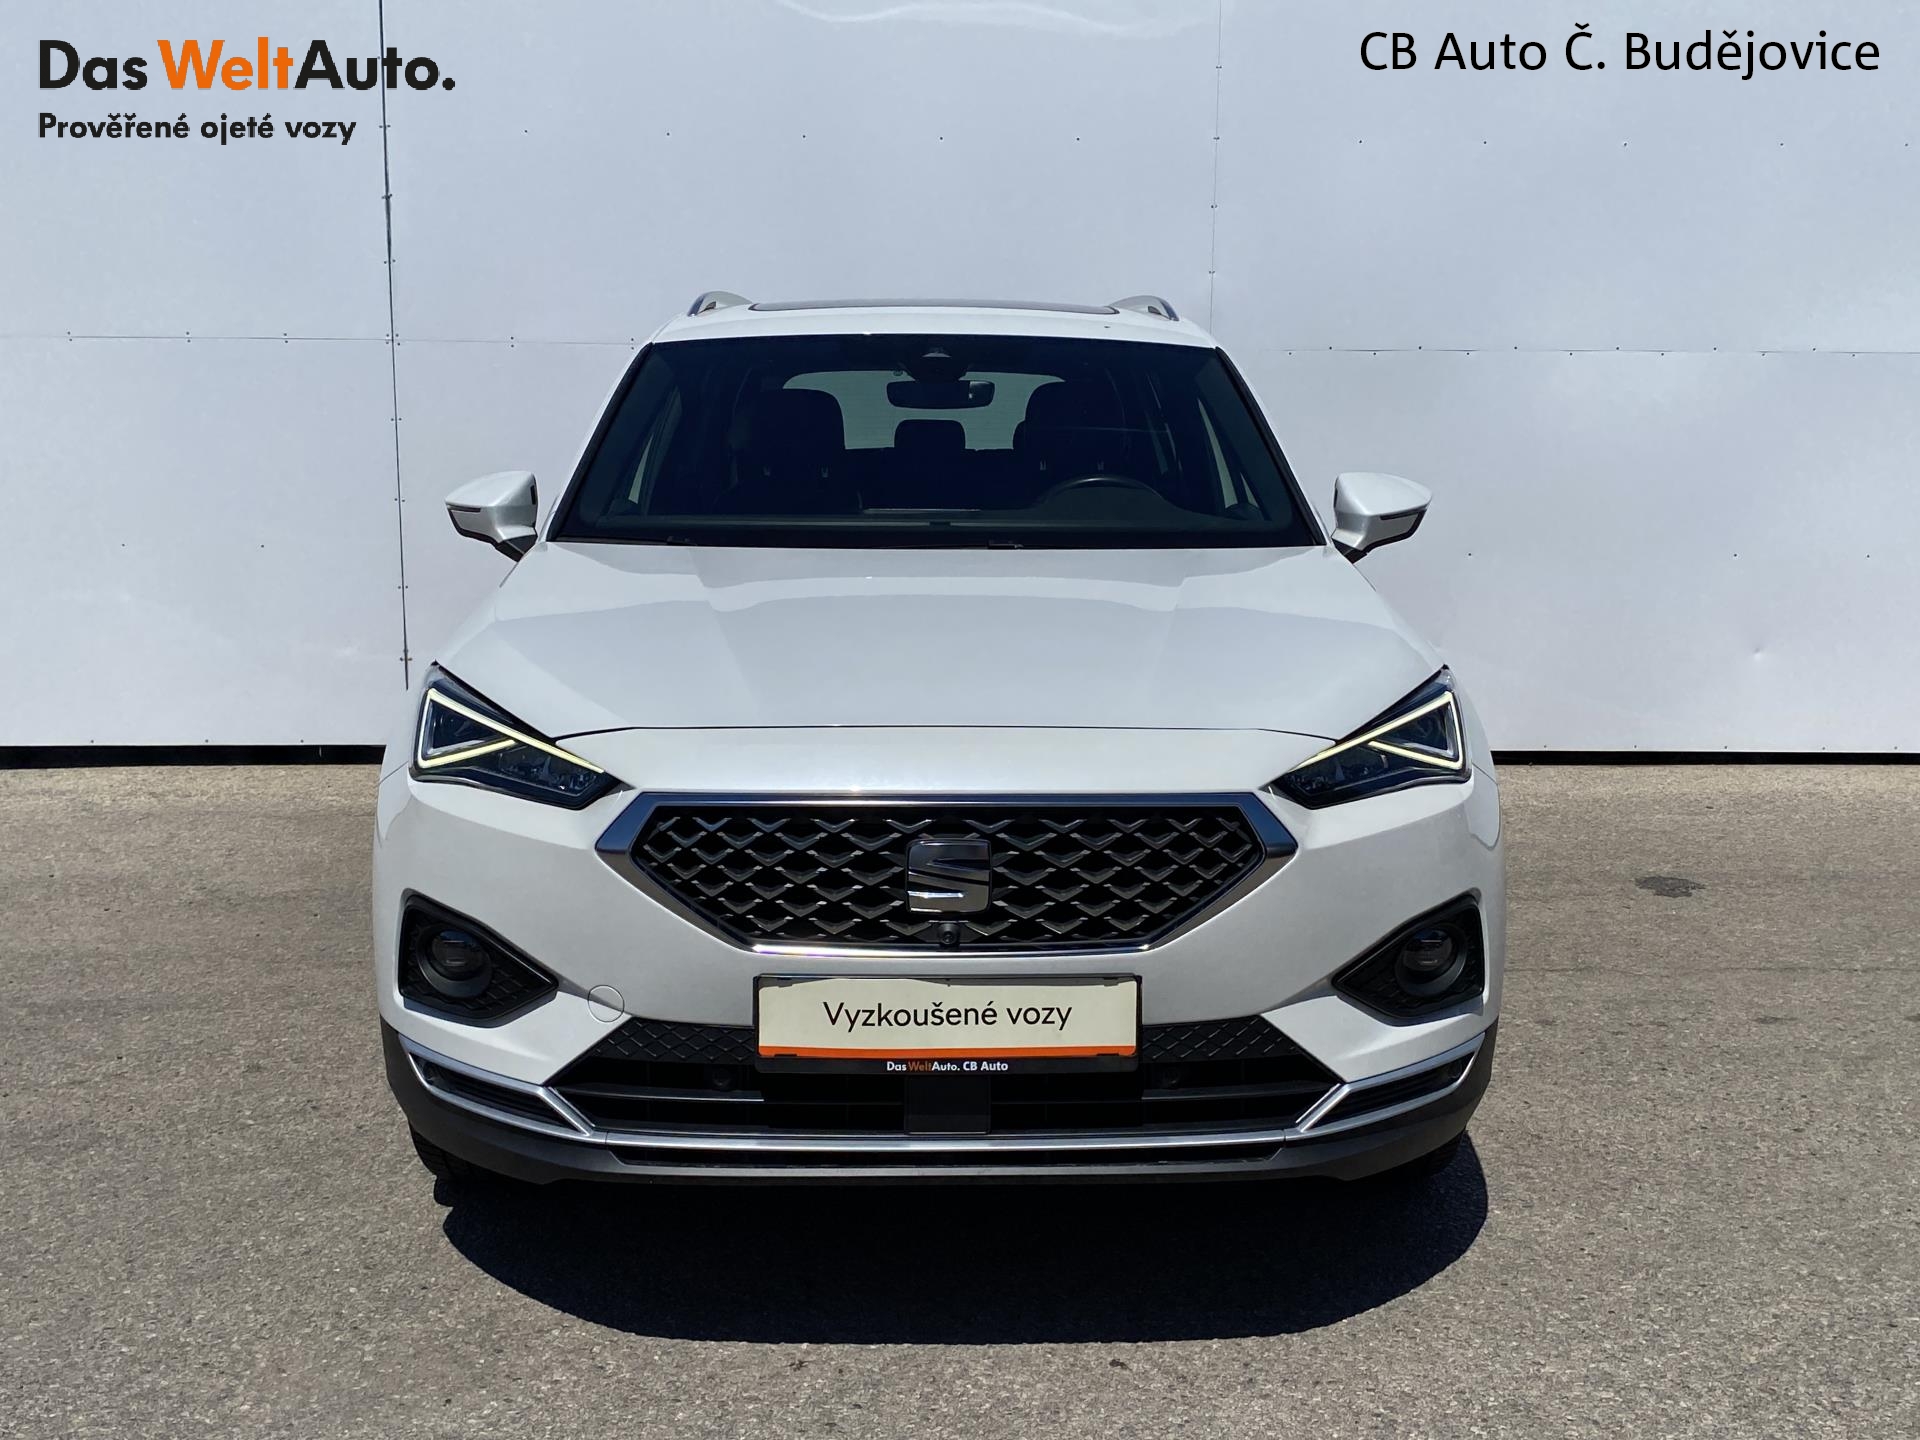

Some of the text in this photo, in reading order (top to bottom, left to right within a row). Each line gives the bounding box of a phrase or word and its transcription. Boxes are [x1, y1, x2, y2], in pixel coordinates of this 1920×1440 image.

[822, 1000, 1073, 1033] Vyzkoušené vozy
[886, 1061, 907, 1071] Das
[962, 1061, 978, 1071] CB
[980, 1061, 1009, 1071] Auto
